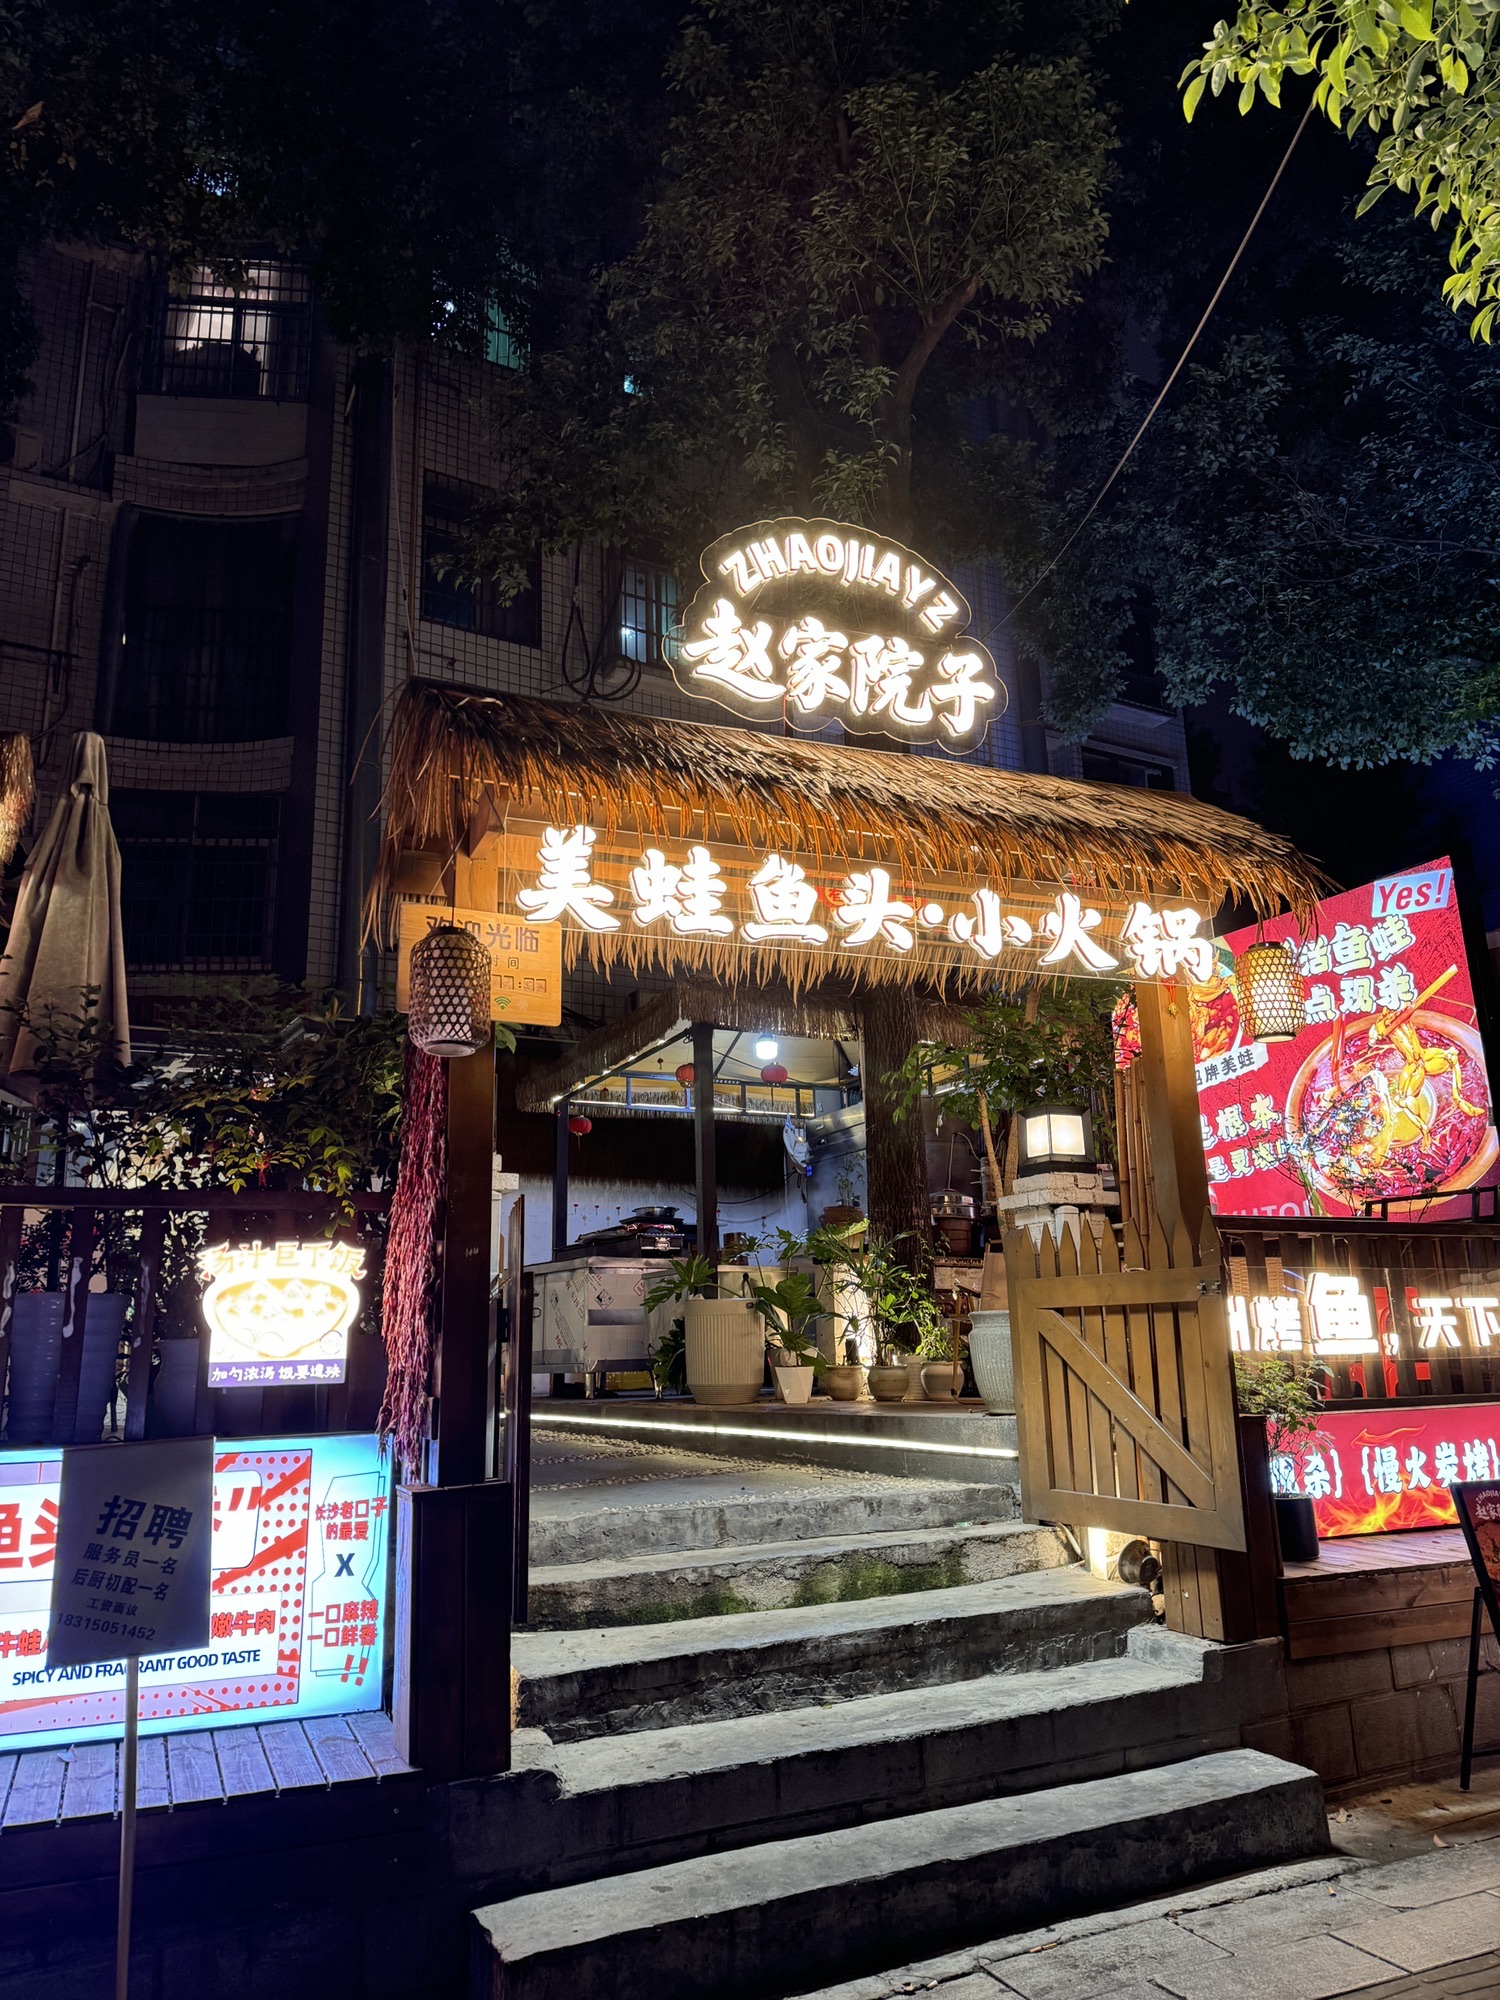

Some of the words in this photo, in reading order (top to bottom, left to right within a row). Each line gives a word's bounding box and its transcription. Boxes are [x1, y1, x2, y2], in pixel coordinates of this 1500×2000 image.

[718, 533, 959, 633] ZHAOJIAYZ
[682, 598, 996, 736] 赵家院子
[1378, 873, 1446, 914] Yes!
[1285, 914, 1416, 978] 活鱼蛙
[96, 1495, 193, 1549] 招聘
[315, 1497, 388, 1521] 长沙老口子
[326, 1521, 368, 1541] 的最爱
[83, 1543, 178, 1575] 服务员一名
[334, 1553, 355, 1577] X
[72, 1568, 170, 1601] 后厨切配一名
[87, 1598, 138, 1617] 工资面议
[308, 1600, 378, 1624] 一口麻辣
[57, 1613, 156, 1641] 18315051452
[307, 1624, 377, 1647] 一口鲜香
[12, 1665, 54, 1686] SPICY
[57, 1663, 92, 1681] AND
[177, 1653, 218, 1670] GOOD
[221, 1650, 261, 1664] TASTE
